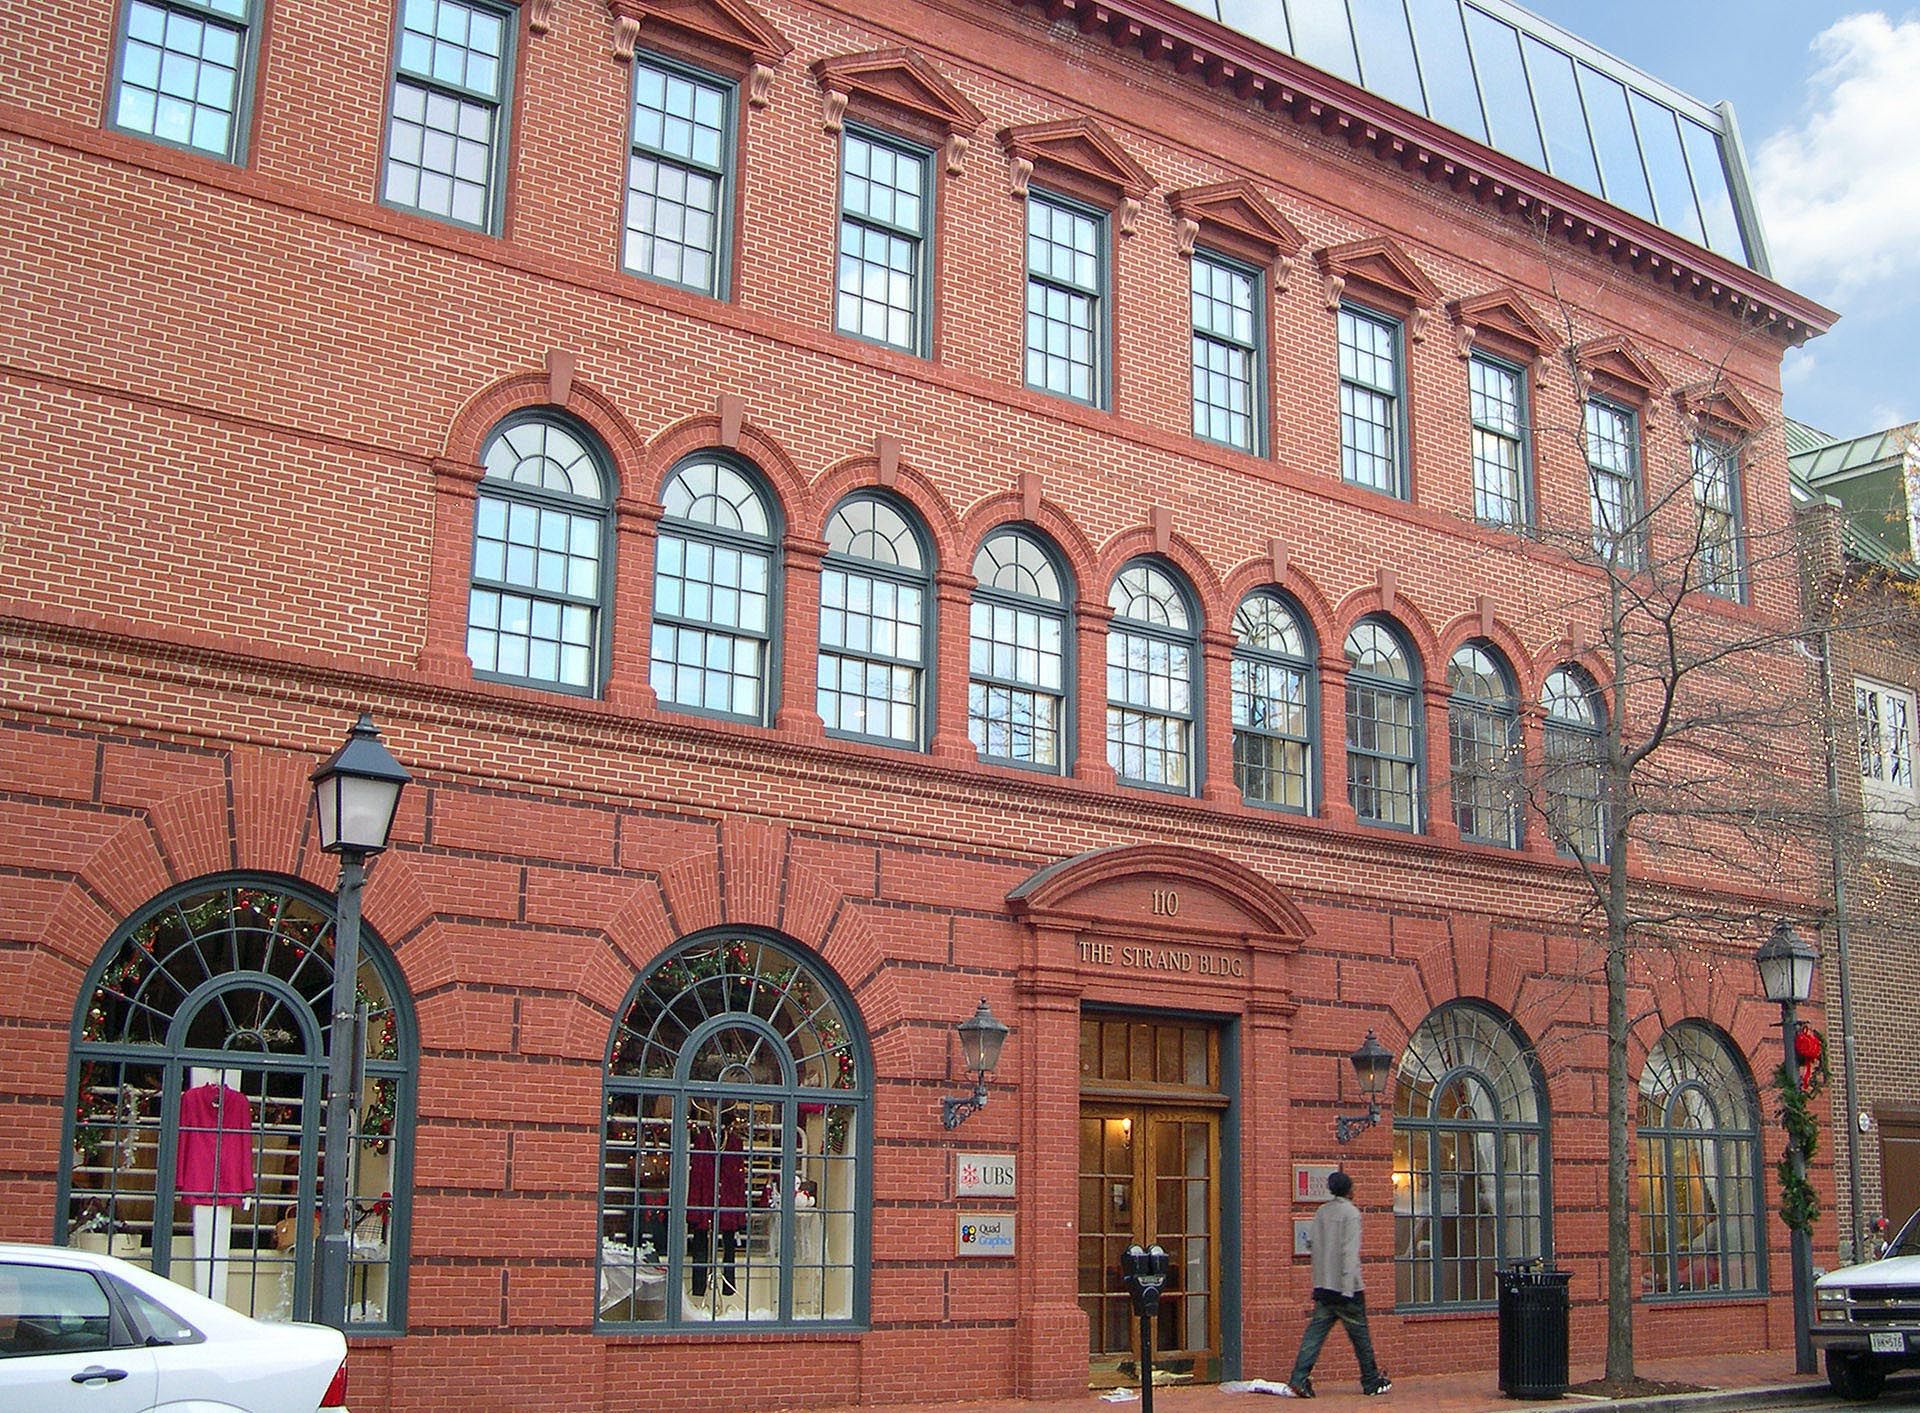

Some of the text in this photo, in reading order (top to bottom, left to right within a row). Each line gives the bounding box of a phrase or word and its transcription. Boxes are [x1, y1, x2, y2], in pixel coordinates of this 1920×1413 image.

[1153, 889, 1179, 915] 110
[1079, 941, 1113, 965] THE
[1122, 946, 1192, 972] STRAND
[983, 1166, 1014, 1185] UBS
[979, 1222, 1001, 1235] Quad
[979, 1235, 1012, 1248] Graphics
